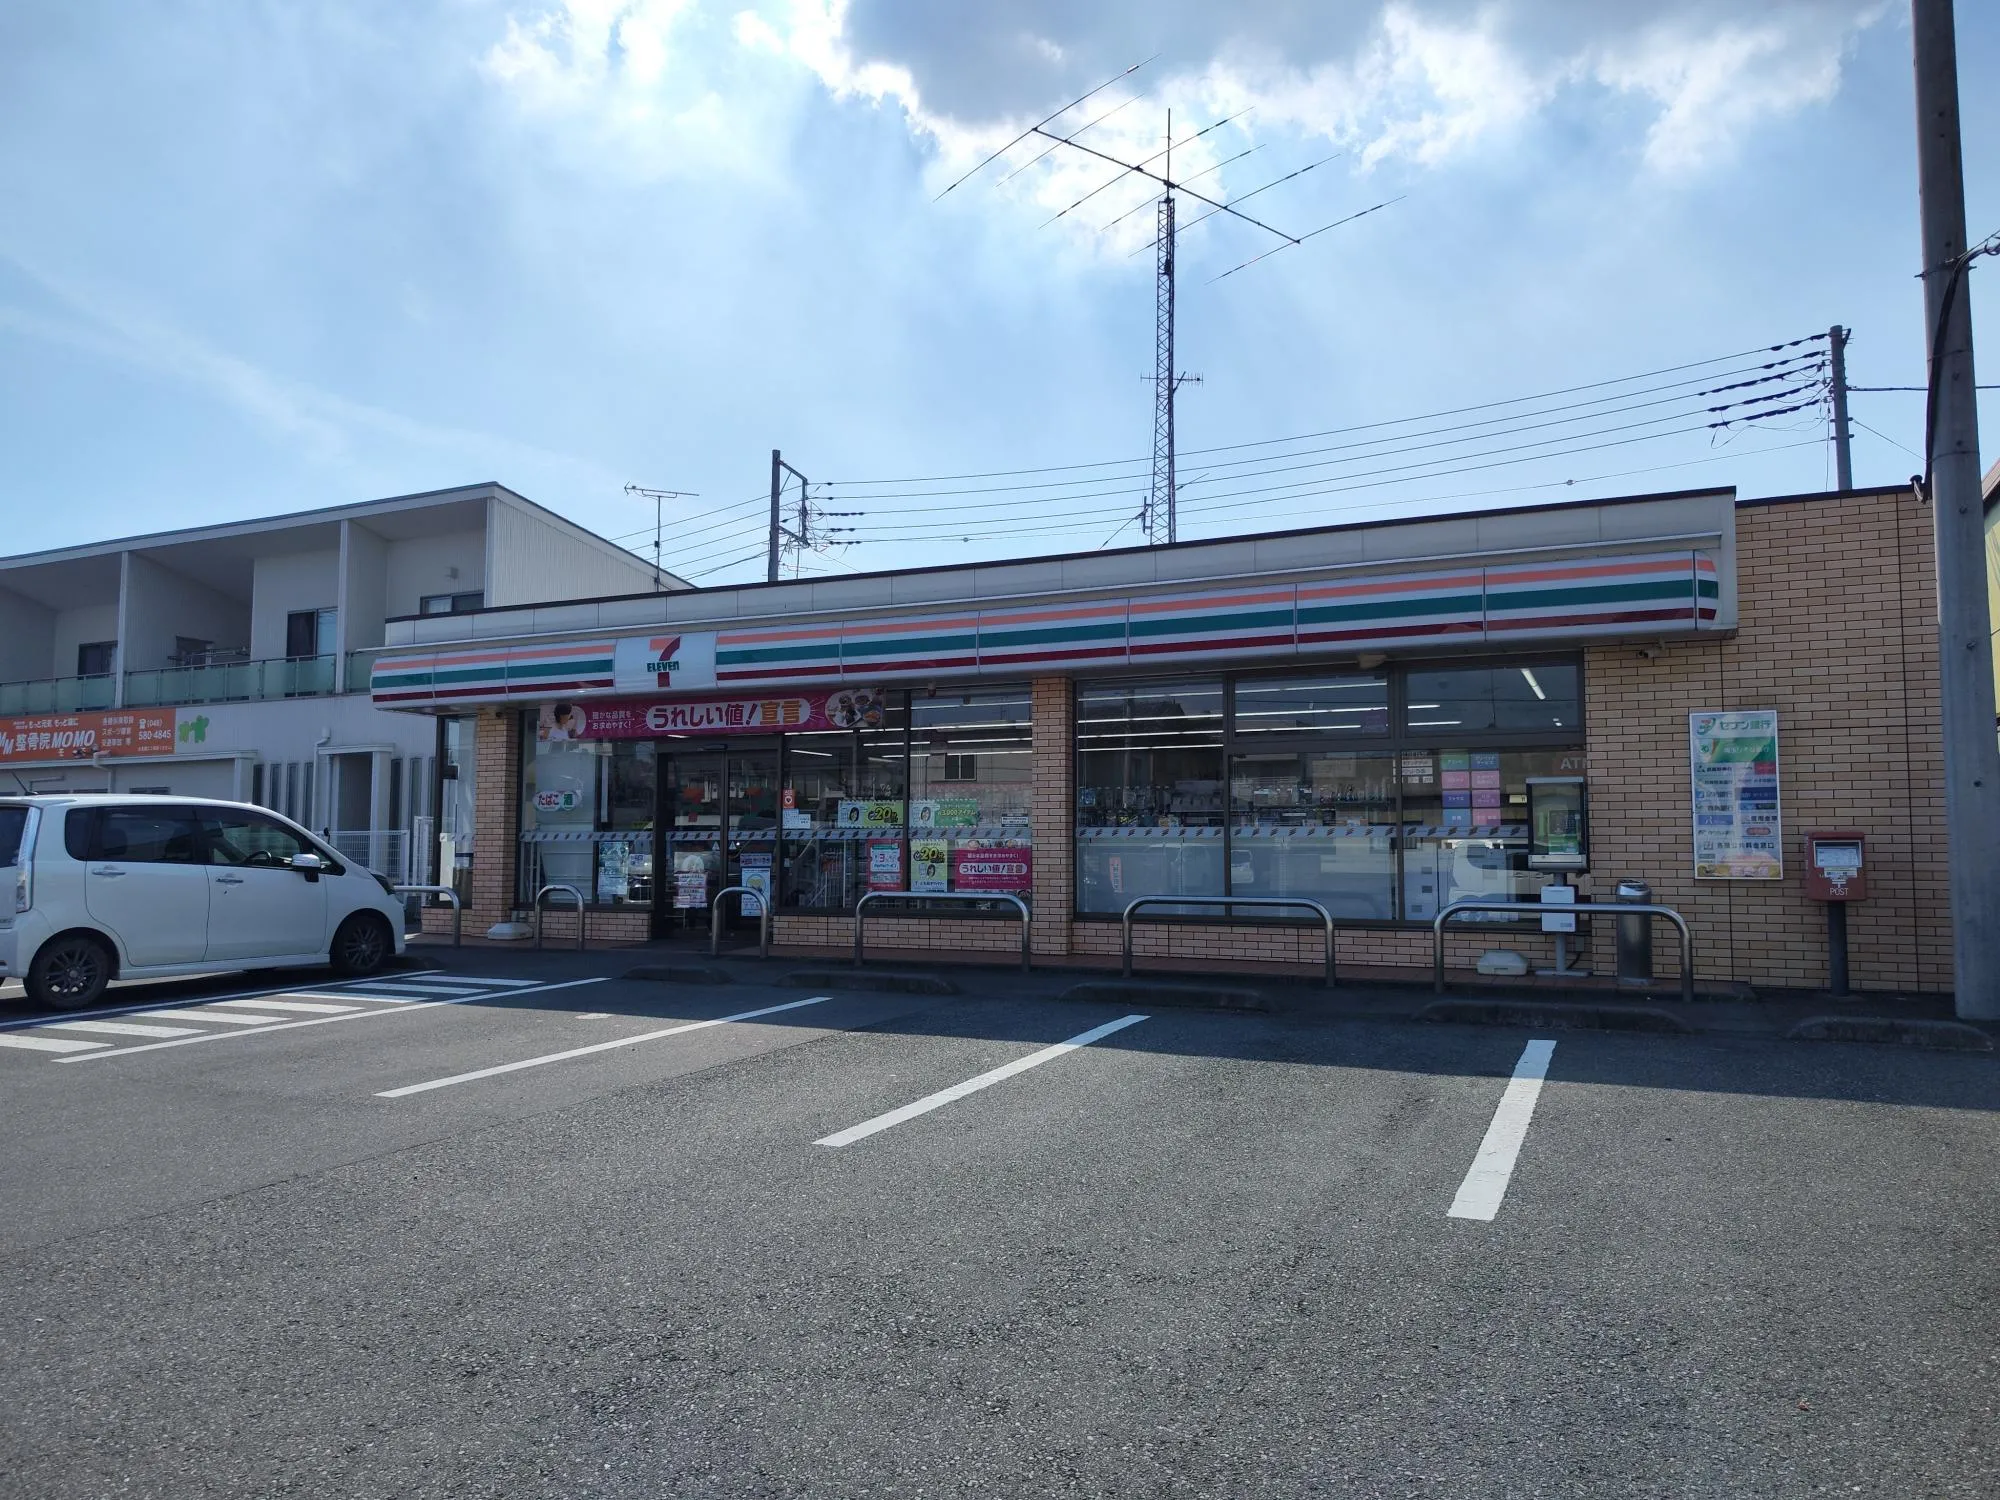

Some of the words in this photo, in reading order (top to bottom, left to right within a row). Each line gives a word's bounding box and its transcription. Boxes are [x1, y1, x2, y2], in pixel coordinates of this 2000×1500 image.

[648, 635, 681, 688] 7
[652, 700, 801, 729] うれしい値!宣言
[538, 794, 560, 806] たばこ
[1829, 888, 1849, 896] POST
